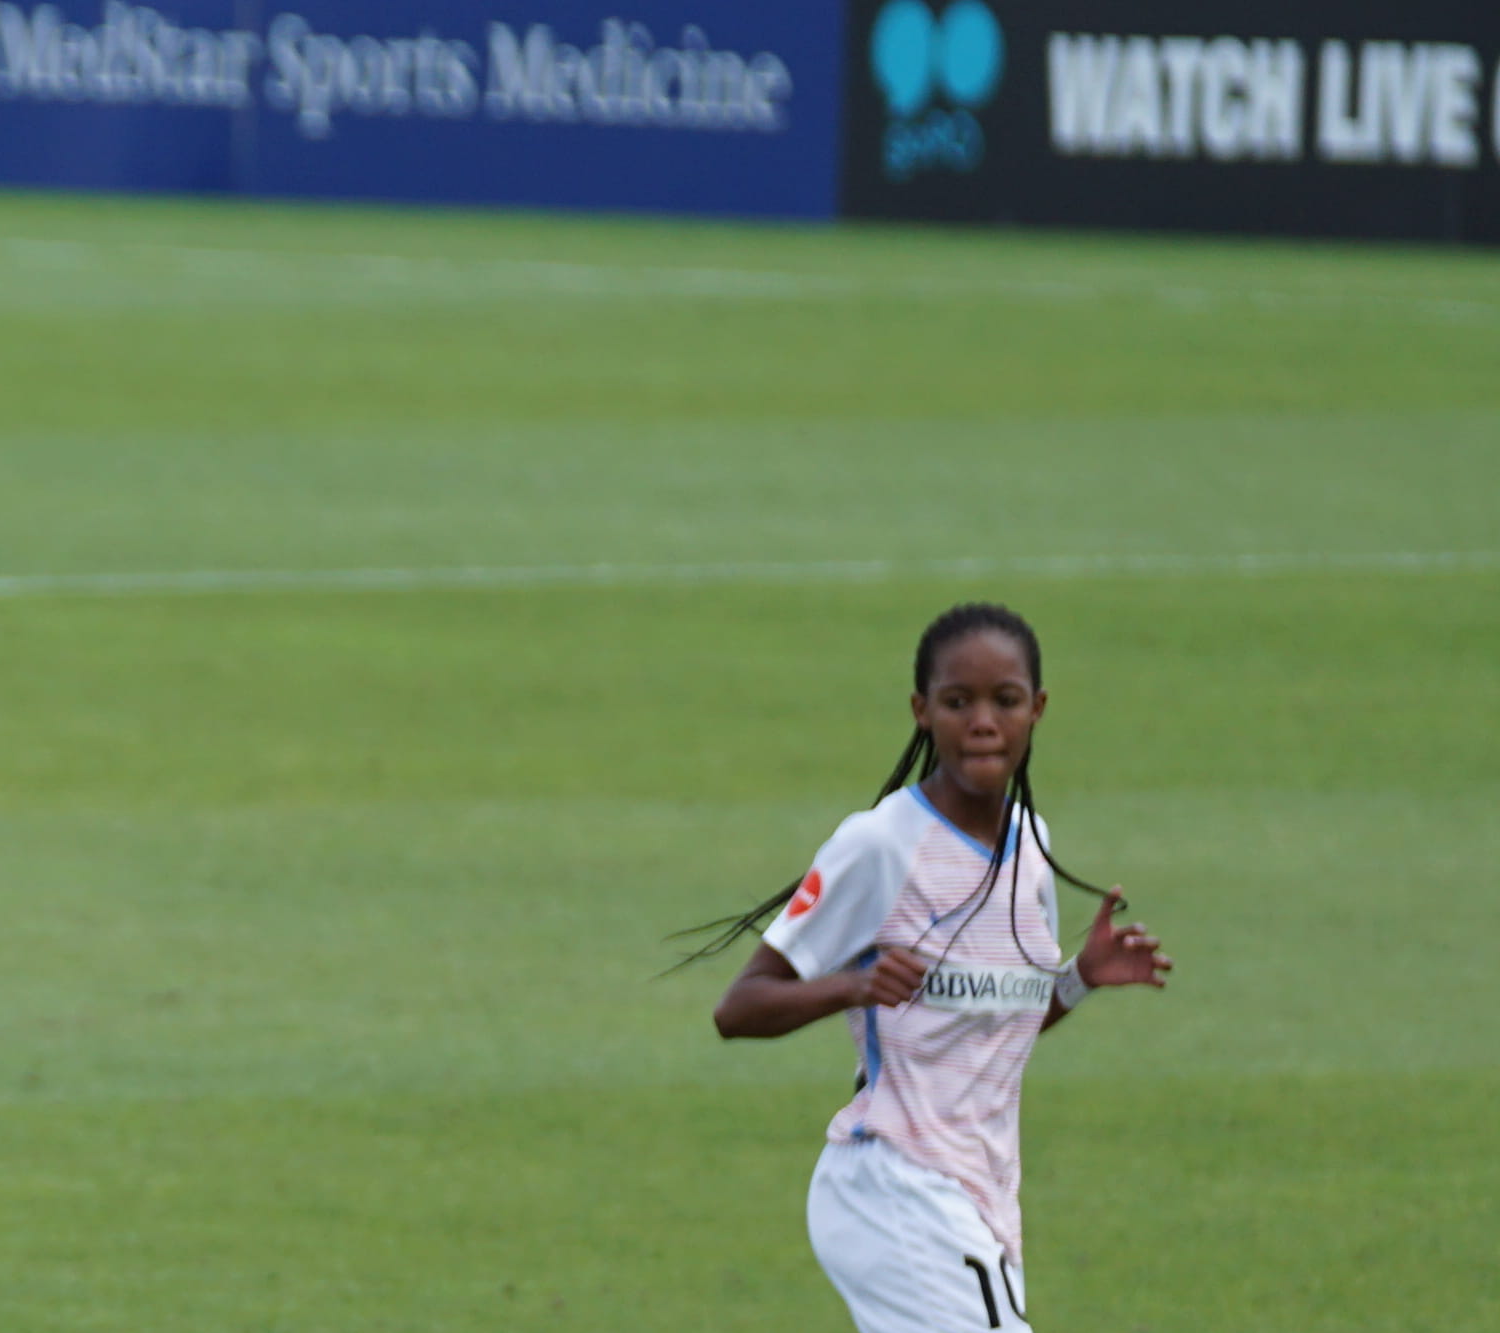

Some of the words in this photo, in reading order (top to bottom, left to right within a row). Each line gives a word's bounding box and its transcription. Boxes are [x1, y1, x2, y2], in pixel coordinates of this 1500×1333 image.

[267, 9, 477, 139] Sports
[485, 17, 792, 131] Medicine
[1046, 31, 1302, 160] WATCH
[1316, 38, 1483, 168] LIVE
[928, 971, 997, 998] BBVA
